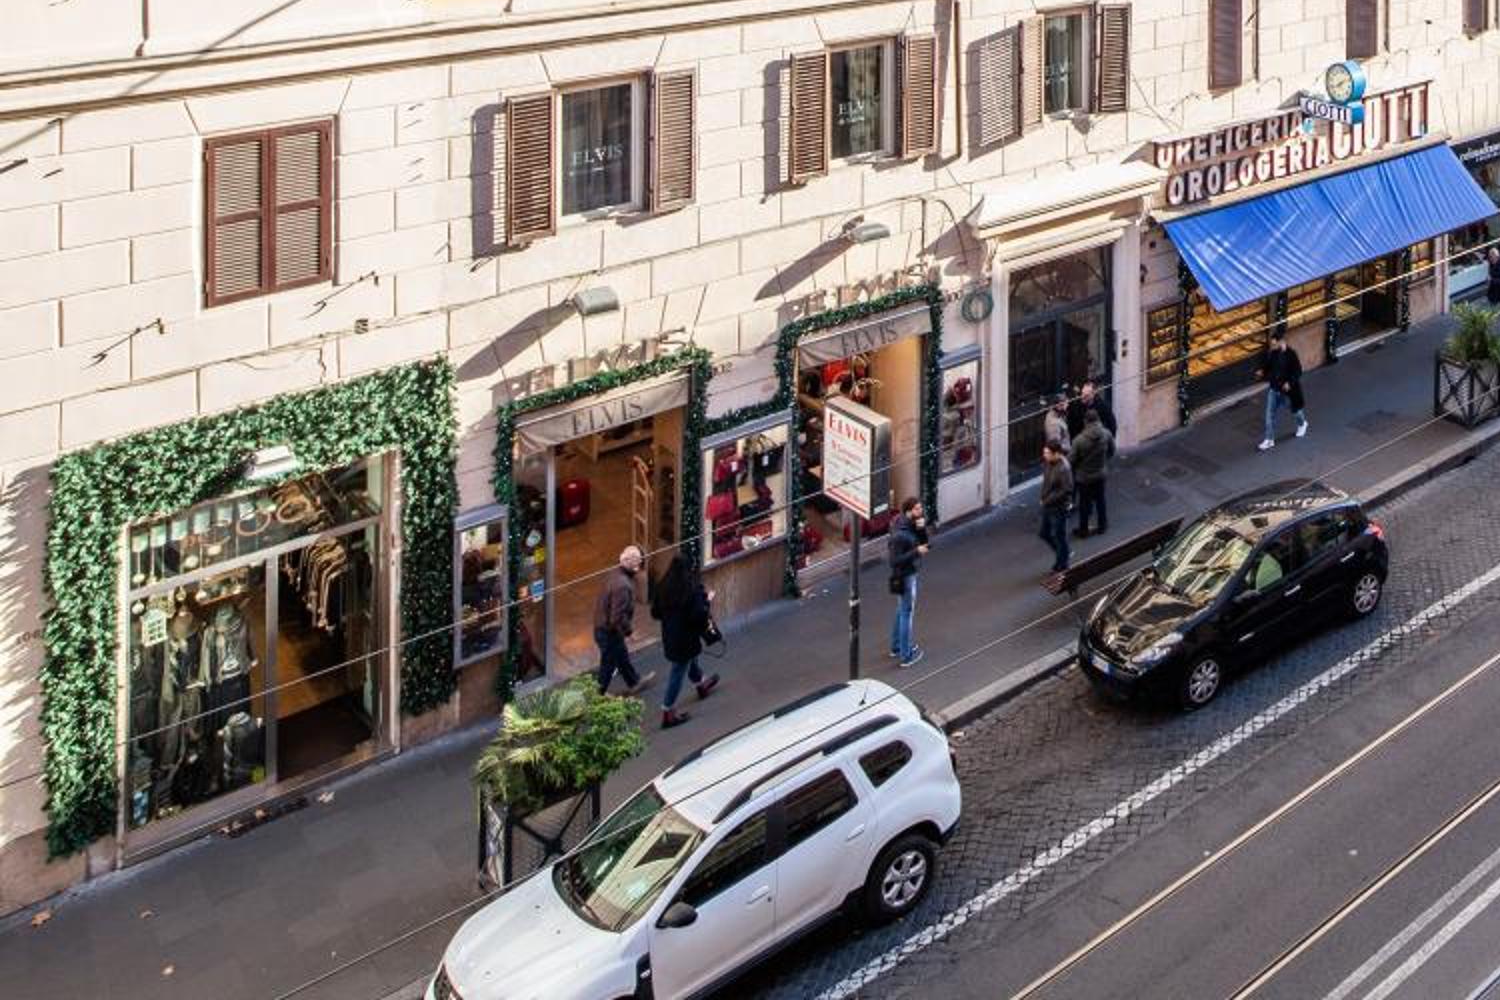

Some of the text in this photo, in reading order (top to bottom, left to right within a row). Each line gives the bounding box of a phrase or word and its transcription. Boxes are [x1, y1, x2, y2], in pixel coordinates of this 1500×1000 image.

[1304, 99, 1348, 121] CIOTTI
[1167, 135, 1331, 205] OROLOGERIA
[841, 320, 898, 356] ELVIS
[571, 394, 644, 436] ELVIS
